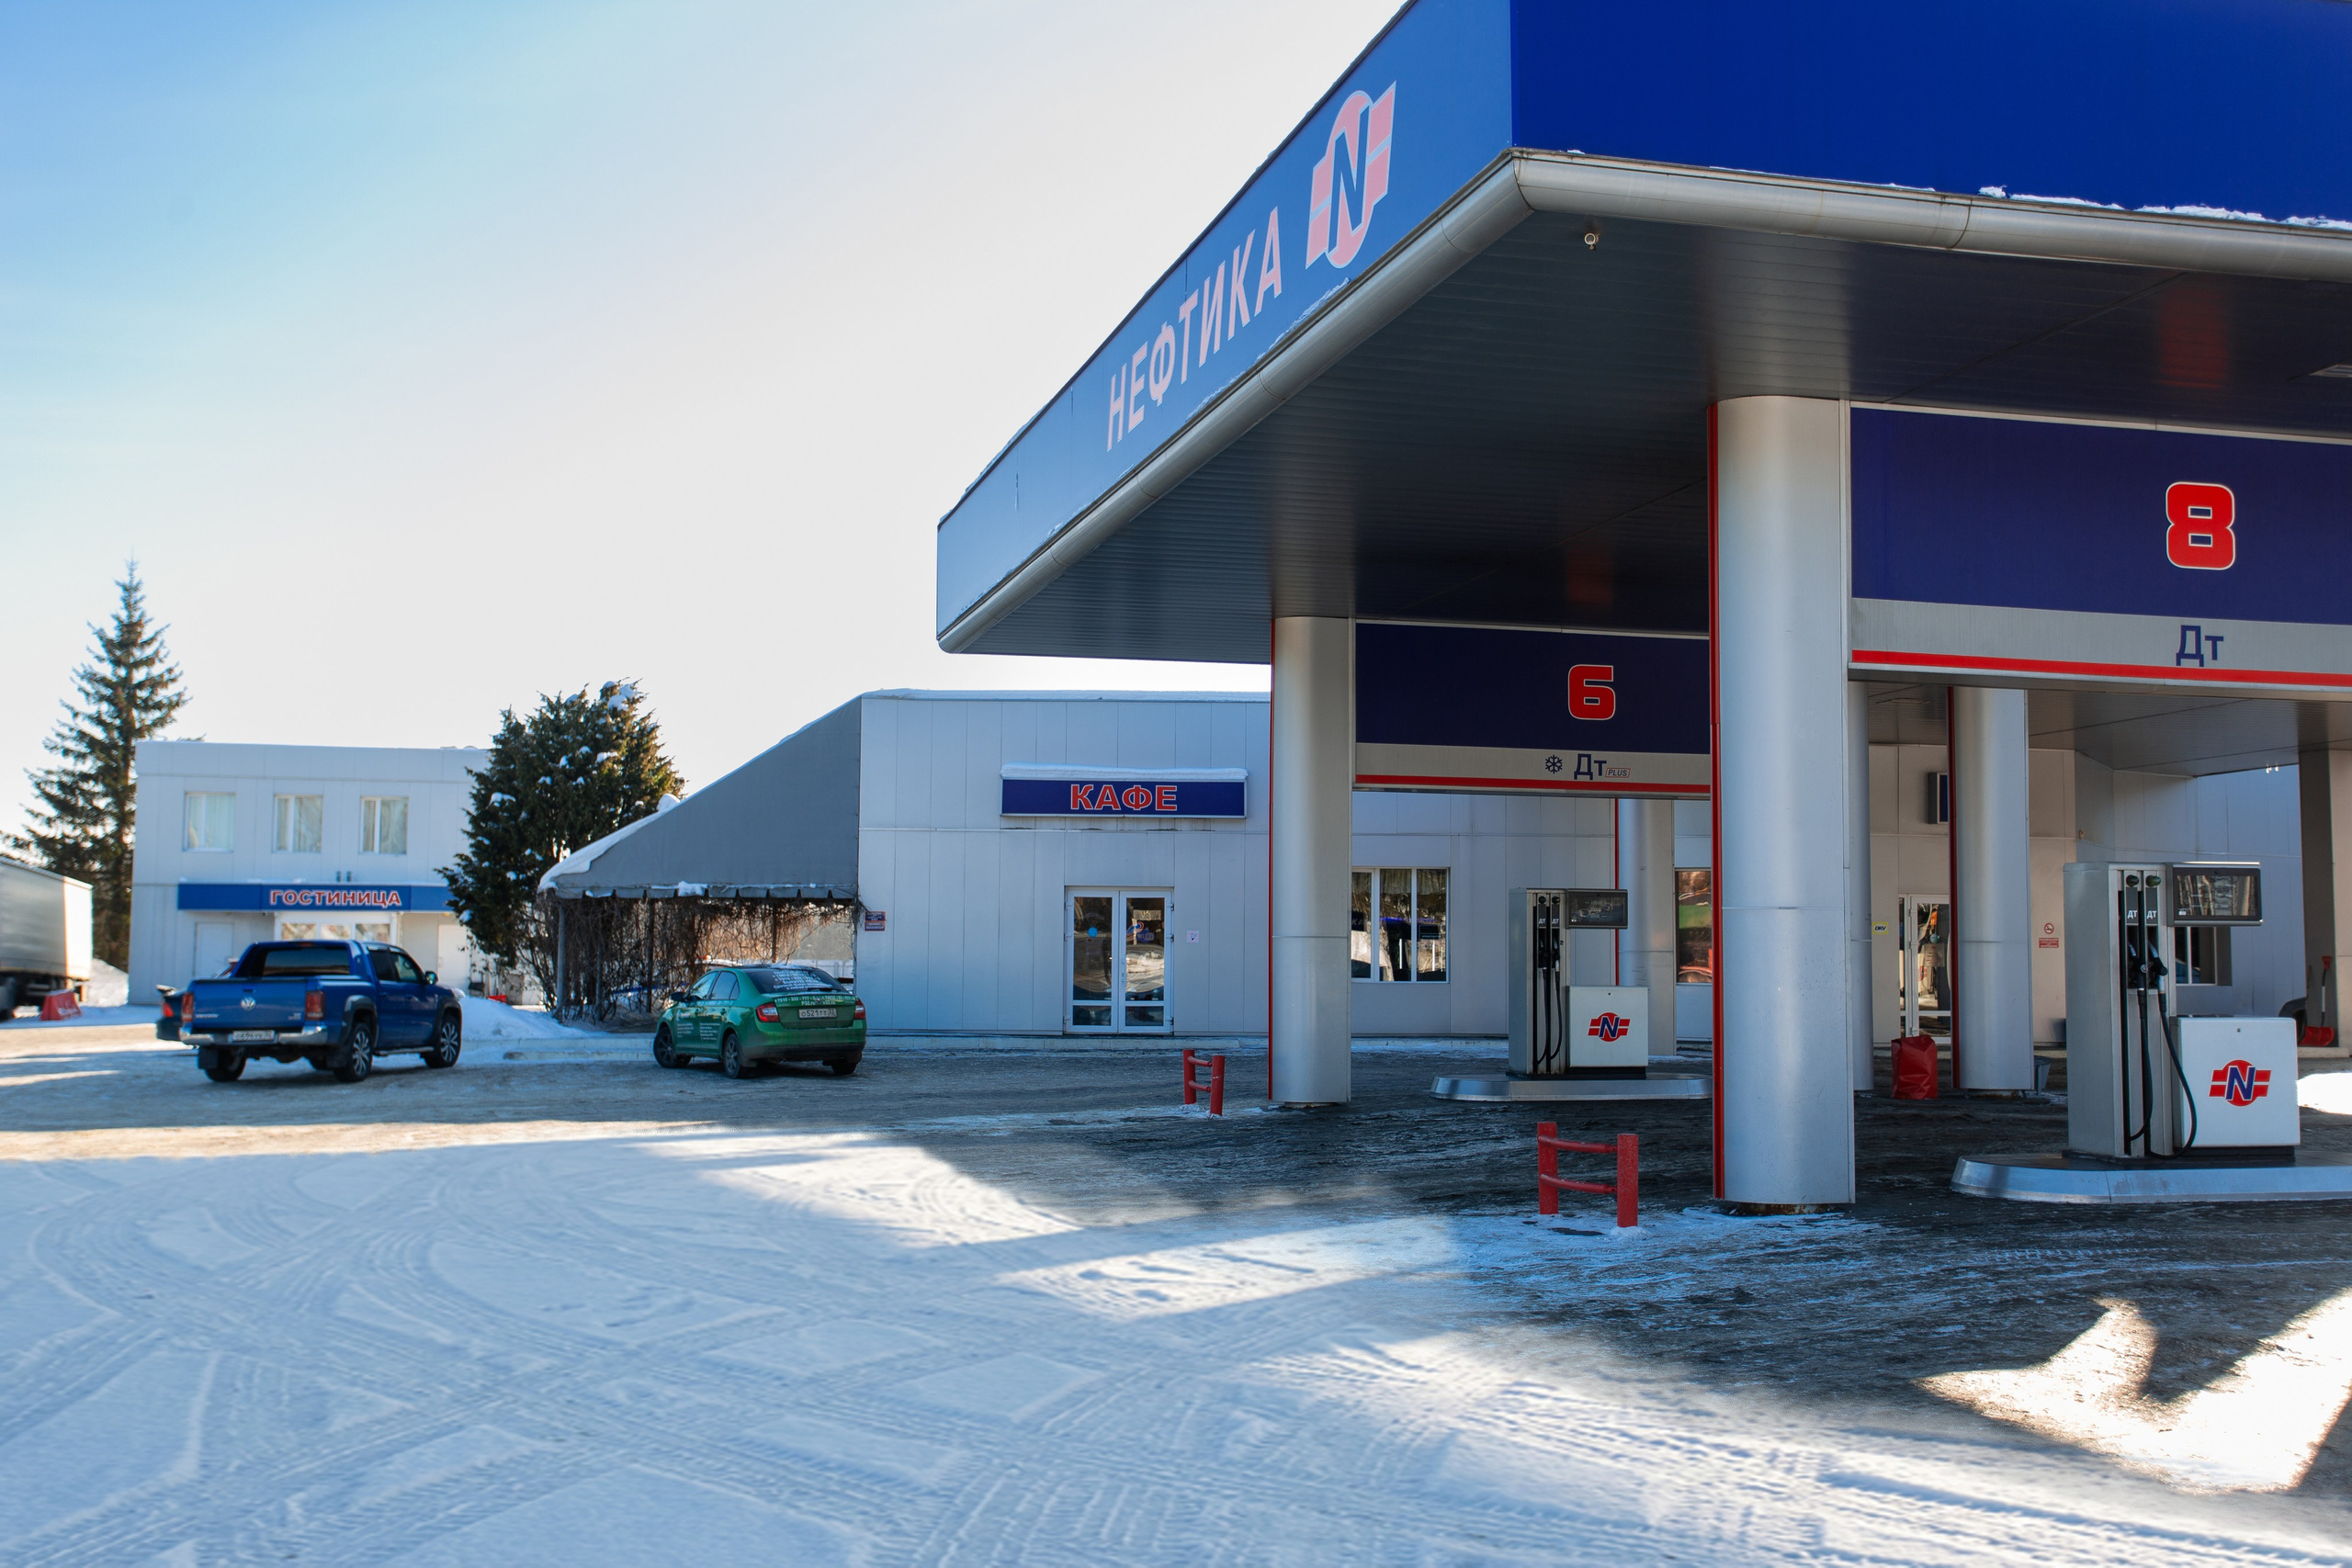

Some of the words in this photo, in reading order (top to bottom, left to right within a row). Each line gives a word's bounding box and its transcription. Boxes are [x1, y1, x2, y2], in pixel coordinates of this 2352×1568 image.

[1107, 206, 1283, 452] НЕФТИКА
[2165, 481, 2236, 570] 8
[1567, 664, 1616, 720] 6
[1607, 769, 1628, 777] PLUS
[1070, 784, 1177, 811] КАФЕ
[269, 889, 402, 909] ГОСТИНИЦА
